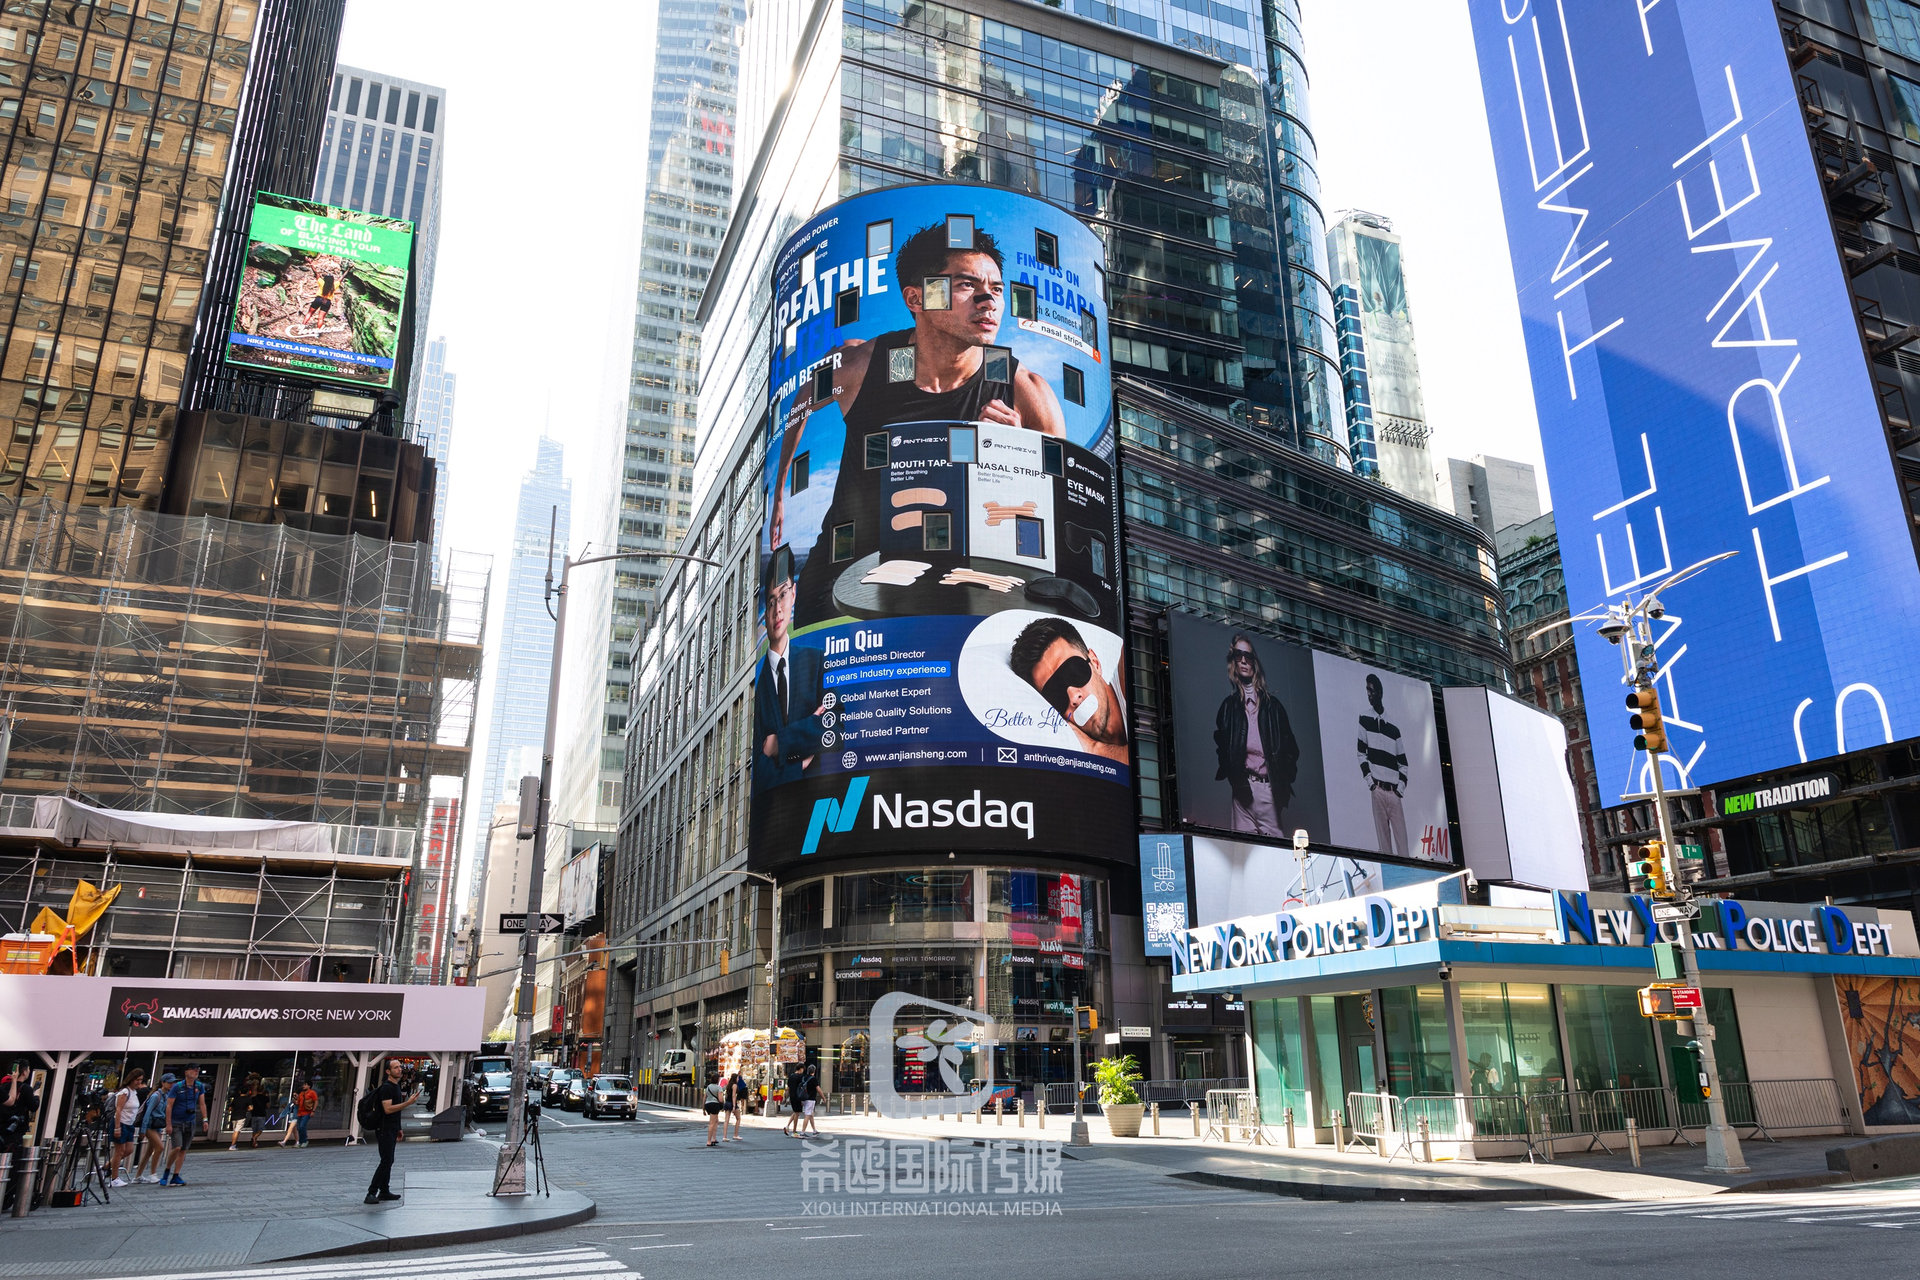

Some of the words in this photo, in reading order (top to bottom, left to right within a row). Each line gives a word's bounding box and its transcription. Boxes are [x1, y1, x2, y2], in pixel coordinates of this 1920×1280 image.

[294, 214, 328, 235] The
[330, 223, 373, 243] Land
[811, 217, 839, 238] POWER
[280, 227, 295, 237] OF
[298, 231, 348, 247] BLAZING
[350, 241, 381, 254] YOUR
[298, 239, 325, 251] OWN
[328, 245, 361, 258] TRAIL
[1017, 251, 1045, 272] FIND
[1065, 269, 1080, 288] ON
[1044, 307, 1051, 318] &
[1052, 310, 1078, 330] Connect
[1041, 324, 1062, 338] nasal
[1063, 333, 1083, 348] strips
[247, 337, 265, 346] HIKE
[318, 349, 355, 361] NATIONAL
[357, 356, 377, 364] PARK
[1672, 65, 1849, 642] TRAVEL
[798, 351, 843, 388] BER
[890, 460, 925, 470] MOUTH
[976, 462, 1010, 473] NASAL
[1013, 466, 1046, 480] STRIPS
[1067, 478, 1084, 493] EYE
[1085, 486, 1106, 505] MASK
[823, 635, 850, 657] Jim
[854, 629, 883, 652] Qiu
[823, 656, 848, 669] Global
[849, 652, 888, 665] Business
[889, 650, 926, 660] Director
[825, 674, 835, 684] 10
[836, 672, 858, 684] years
[860, 667, 895, 679] Industry
[896, 665, 947, 676] experience
[840, 691, 867, 703] Global
[868, 688, 900, 700] Market
[901, 687, 932, 698] Expert
[840, 710, 873, 722] Reliable
[875, 707, 907, 718] Quality
[909, 705, 952, 715] Solutions
[984, 708, 1034, 728] Better
[839, 731, 858, 741] Your
[859, 726, 893, 739] Trusted
[895, 725, 930, 736] Partner
[864, 749, 968, 762] www.anjiansheng.com
[1023, 752, 1117, 776] anthrive@anjiansheng.com
[873, 789, 1035, 841] Nasdaq
[427, 807, 448, 867] PARK
[1420, 824, 1449, 860] H&M
[1552, 888, 1633, 946] NEW
[1717, 899, 1821, 953] POLICE
[1819, 905, 1893, 956] DEPT
[1656, 908, 1671, 916] ONE
[1677, 905, 1693, 915] WAY
[415, 903, 436, 967] PARK
[506, 919, 525, 928] ONE
[1171, 931, 1217, 976] NEW
[1215, 923, 1276, 969] YORK
[1276, 912, 1361, 961] POLICE
[1364, 895, 1439, 948] DEPT
[860, 956, 882, 964] Nasdaq
[891, 955, 918, 963] REWRITE
[1012, 955, 1035, 965] Nasdaq
[161, 1006, 222, 1019] TAMASHII
[281, 1008, 323, 1021] STORE
[326, 1009, 356, 1020] NEW
[357, 1009, 392, 1021] YORK
